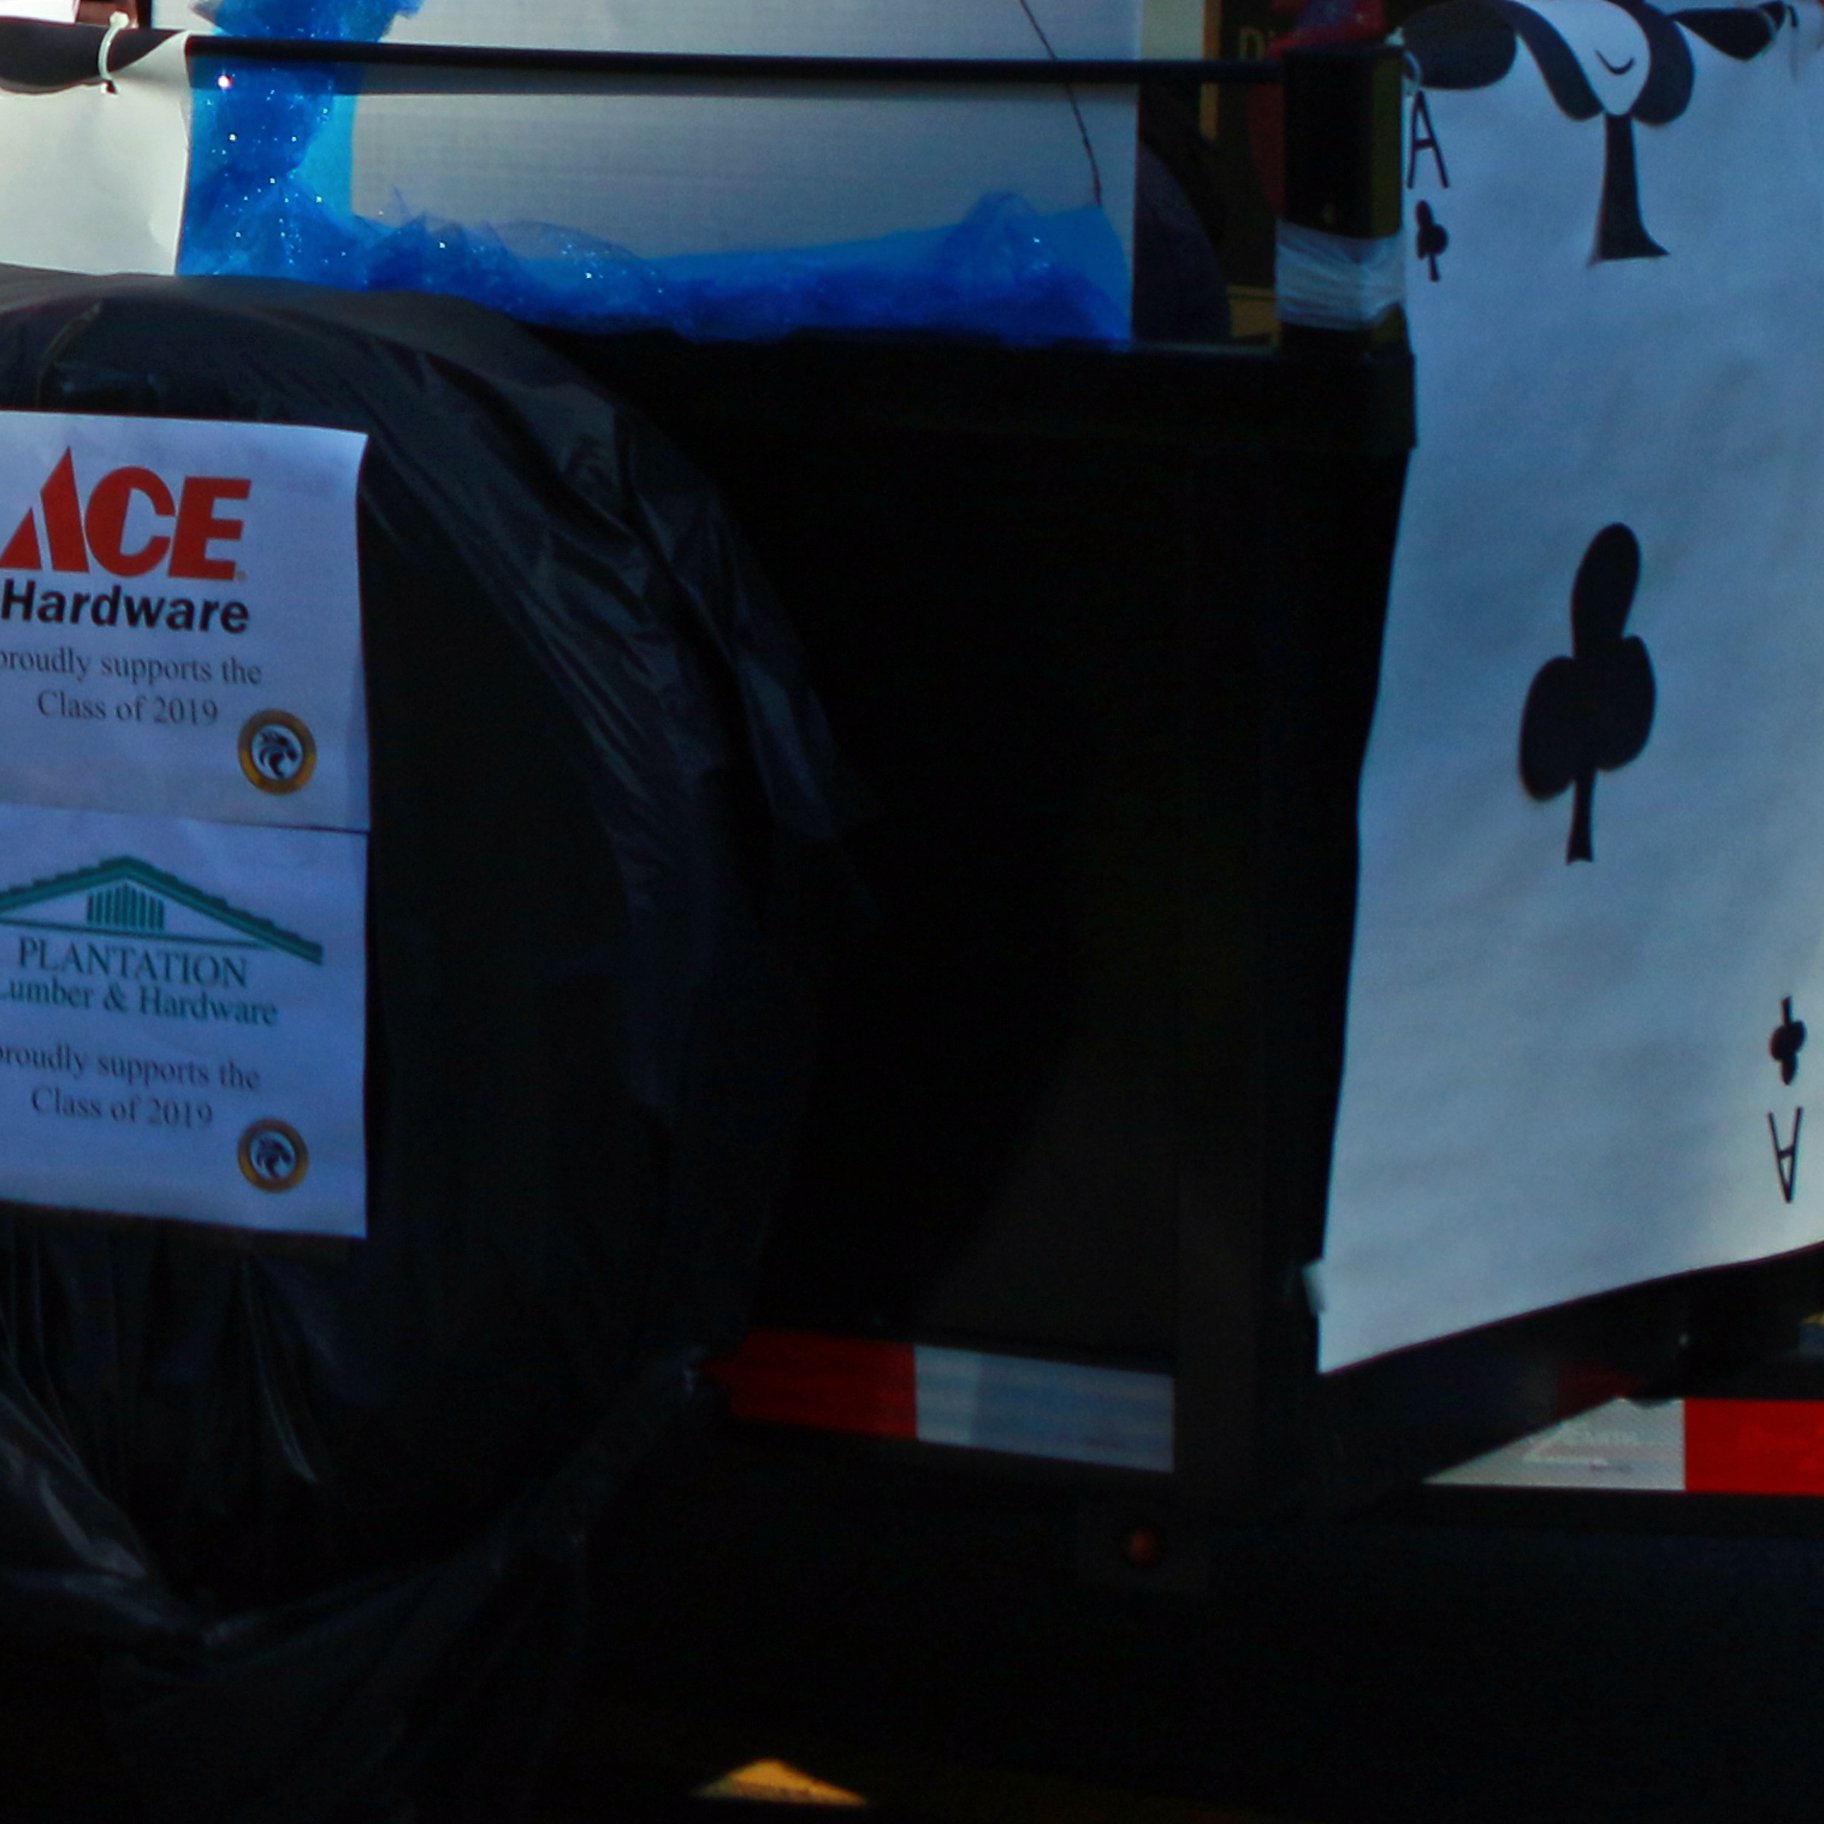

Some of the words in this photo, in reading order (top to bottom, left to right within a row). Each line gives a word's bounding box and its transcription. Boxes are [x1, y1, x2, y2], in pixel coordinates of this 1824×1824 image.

[1407, 90, 1449, 189] A
[0, 578, 250, 635] Hardware
[101, 655, 213, 686] supports
[221, 656, 263, 686] the
[37, 689, 107, 720] Class
[115, 696, 146, 722] of
[153, 697, 219, 725] 2019
[18, 936, 249, 989] PLANTATION
[102, 981, 129, 1013] &
[138, 985, 279, 1026] Hardware
[97, 1052, 210, 1087] supports
[219, 1060, 261, 1090] the
[31, 1085, 102, 1118] Class
[110, 1092, 141, 1124] of
[148, 1097, 213, 1127] 2019
